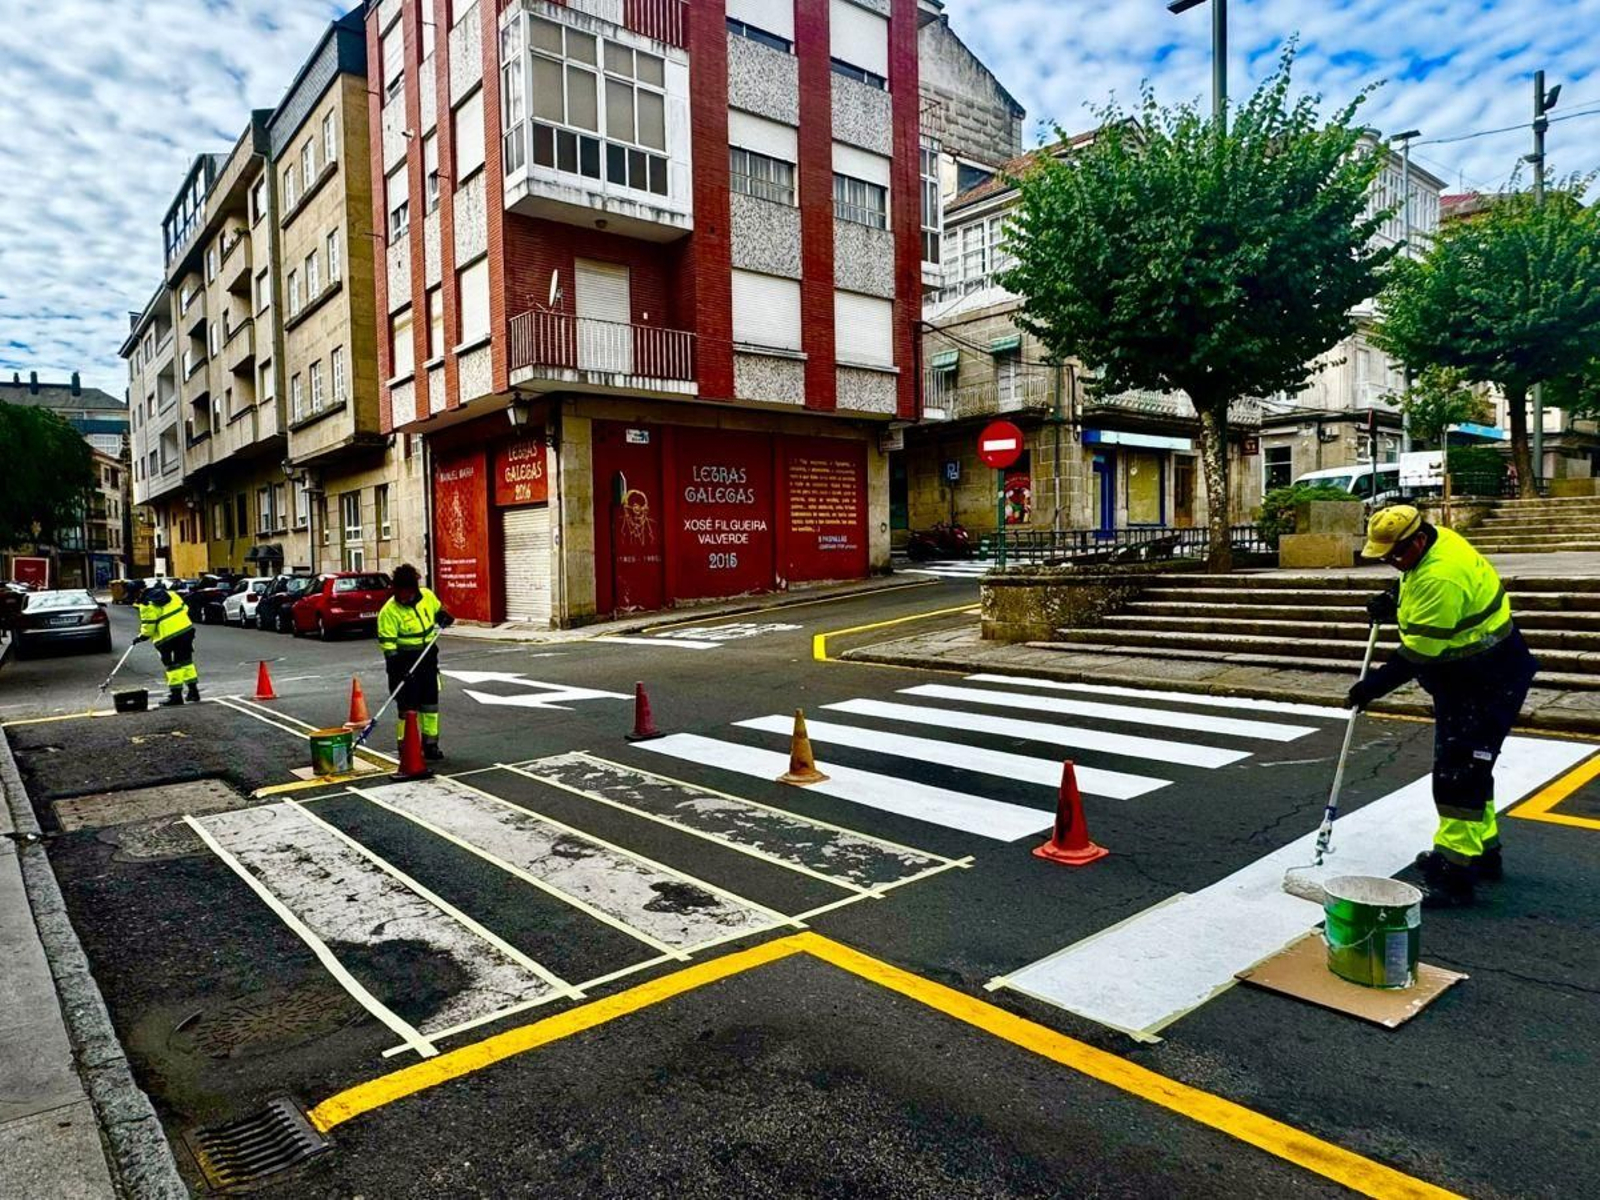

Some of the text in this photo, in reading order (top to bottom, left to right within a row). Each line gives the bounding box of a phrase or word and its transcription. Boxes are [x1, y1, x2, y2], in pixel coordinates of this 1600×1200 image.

[505, 461, 542, 483] GALEGAS
[692, 465, 747, 485] LETRAS
[684, 486, 755, 504] GALEGAS
[684, 517, 713, 531] XOSÉ
[698, 533, 749, 544] VALVERDE
